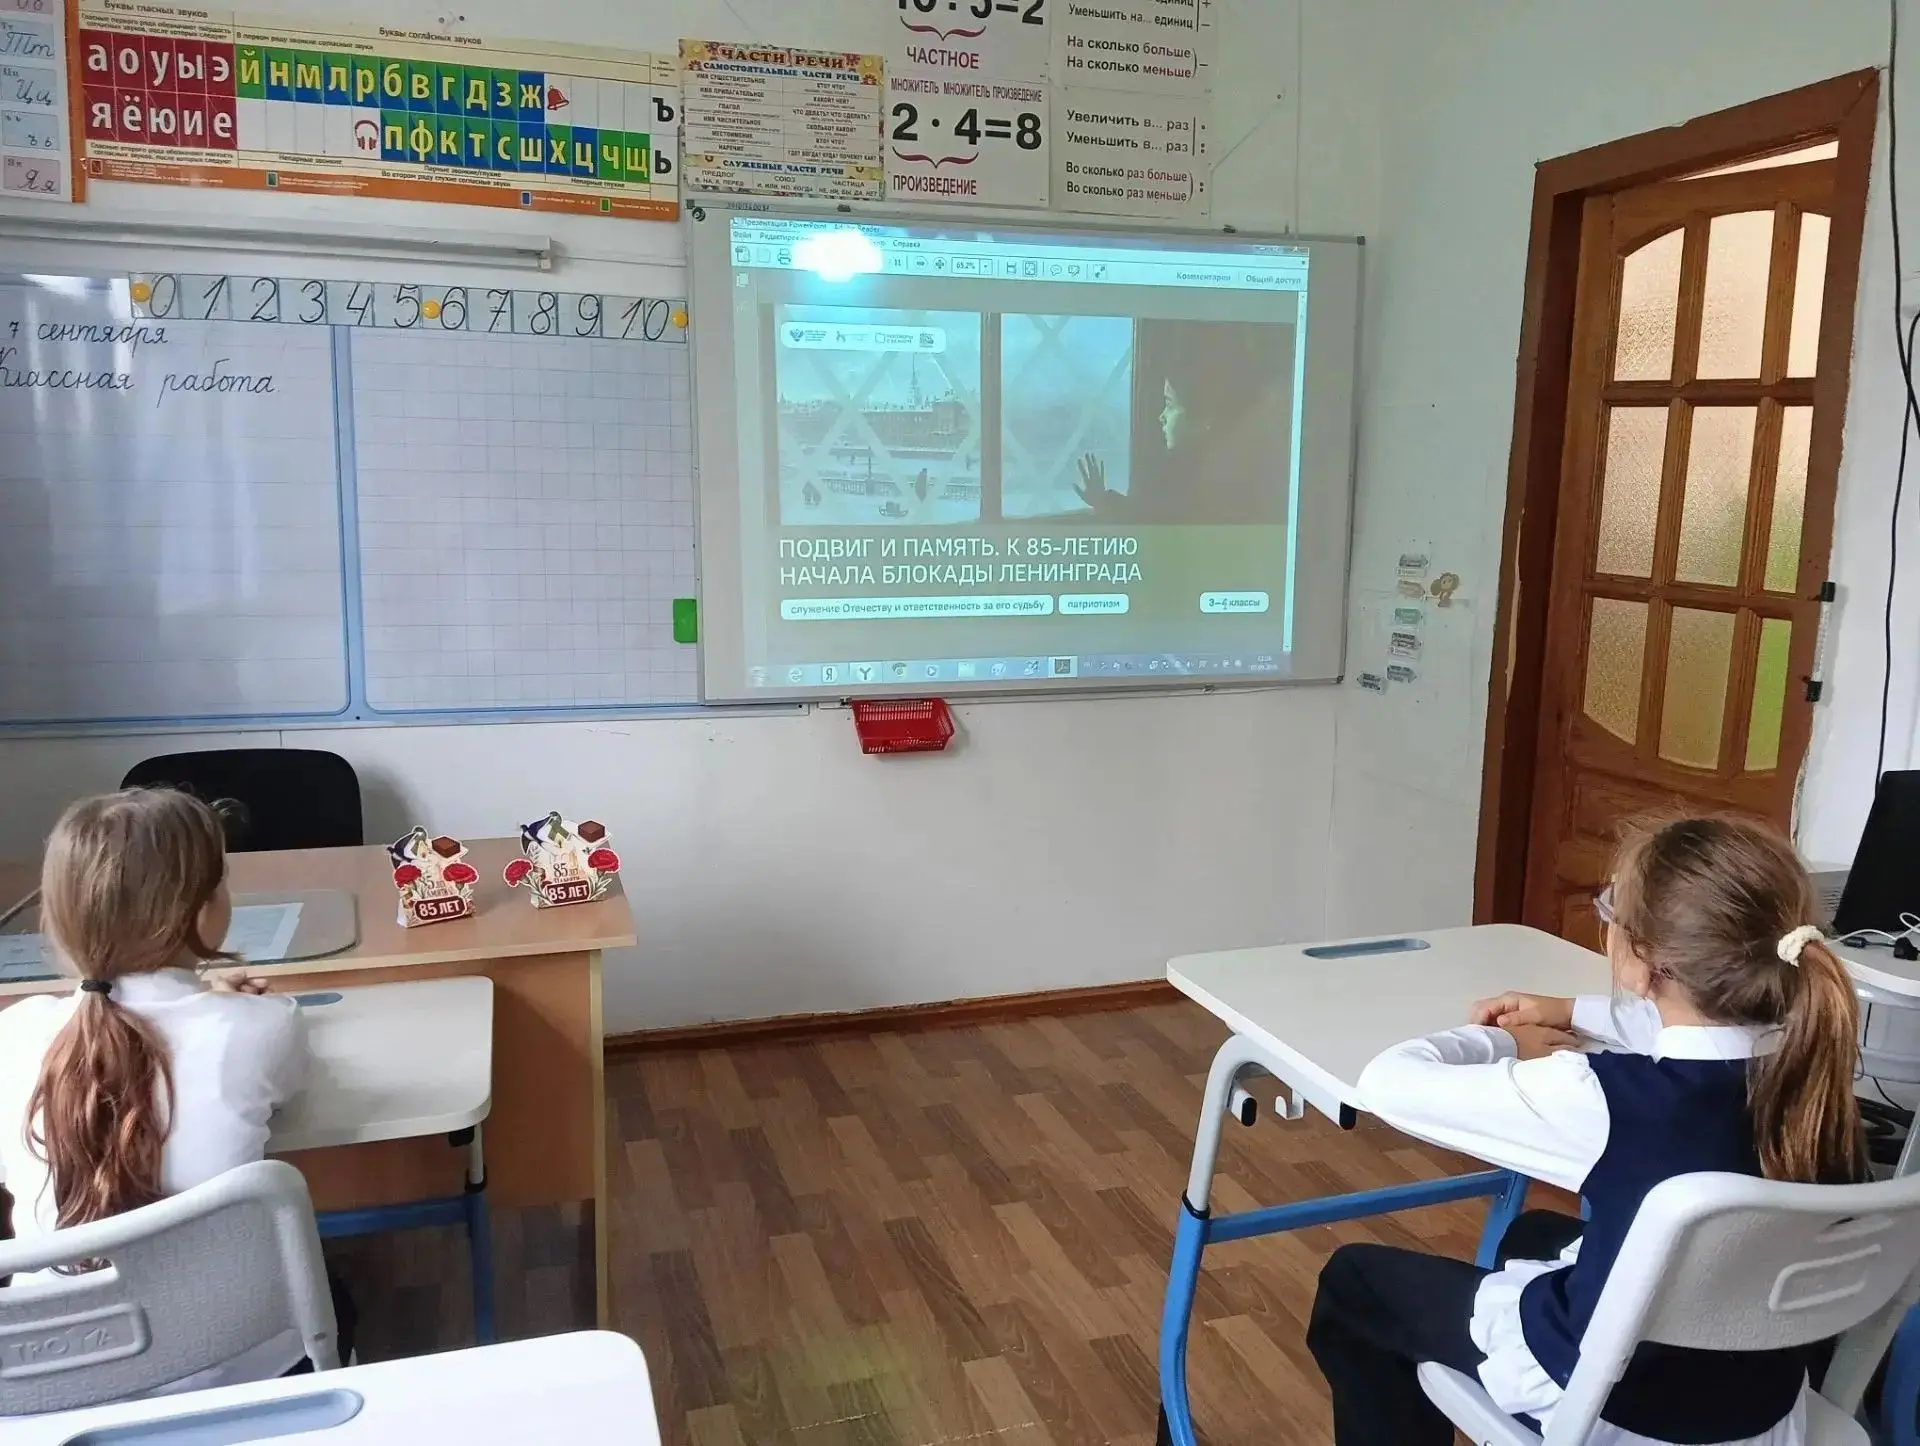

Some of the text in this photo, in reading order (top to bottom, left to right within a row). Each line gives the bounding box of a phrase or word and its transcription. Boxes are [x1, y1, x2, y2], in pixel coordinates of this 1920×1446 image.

[1069, 3, 1127, 21] Уменьшить
[1155, 15, 1193, 29] единиц
[379, 27, 406, 37] Буквы
[721, 48, 843, 69] ЧАСТИ РЕЧИ
[906, 46, 980, 69] ЧАСТНОЕ
[1067, 35, 1191, 59] На сколько больше
[703, 62, 860, 81] САМОСТОЯТЕЛЬНЫЕ ЧАСТИ РЕЧИ
[1067, 55, 1191, 79] На сколько меньше
[891, 77, 1042, 103] МНОЖИТЕЛЬ МНОЖИТЕЛЬ ПРОИЗВЕДЕНИЕ
[1067, 109, 1140, 127] Увеличить
[1167, 120, 1189, 132] раз
[1067, 131, 1138, 149] Уменьшить
[1166, 142, 1188, 154] раз
[723, 160, 844, 175] СЛУЖЕБНЫЕ ЧАСТИ РЕЧИ
[1066, 161, 1187, 182] Во сколько раз больше
[893, 175, 977, 196] ПРОИЗВЕДЕНИЕ
[1067, 181, 1187, 202] Во сколько раз меньше
[892, 239, 921, 249] Справка
[1176, 271, 1231, 283] Комментарии
[1245, 274, 1301, 287] Общий доступ
[149, 274, 177, 318] 0
[203, 276, 228, 320] 1
[250, 277, 278, 322] 2
[298, 280, 325, 323] 3
[345, 282, 372, 326] 4
[394, 284, 420, 328] 5
[440, 287, 466, 330] 6
[487, 289, 511, 333] 7
[530, 291, 556, 336] 8
[575, 294, 600, 336] 9
[621, 298, 670, 341] 10
[8, 317, 169, 359] 7 сентября
[779, 537, 1138, 562] ПОДВИГ И ПАМЯТЬ. К 85-ЛЕТИЮ
[780, 563, 1143, 586] НАЧАЛА БЛОКАДЫ ЛЕНИНГРАДА
[790, 605, 840, 615] служение
[843, 603, 893, 615] Отечеству
[903, 602, 981, 612] ответственность
[983, 602, 993, 610] за
[996, 602, 1011, 612] его
[1012, 600, 1045, 613] судьбу
[1067, 600, 1120, 610] патриотизм
[1229, 599, 1260, 608] классы
[553, 862, 568, 878] 85
[549, 885, 588, 901] 85 ЛЕТ
[419, 900, 460, 917] 85 ЛЕТ
